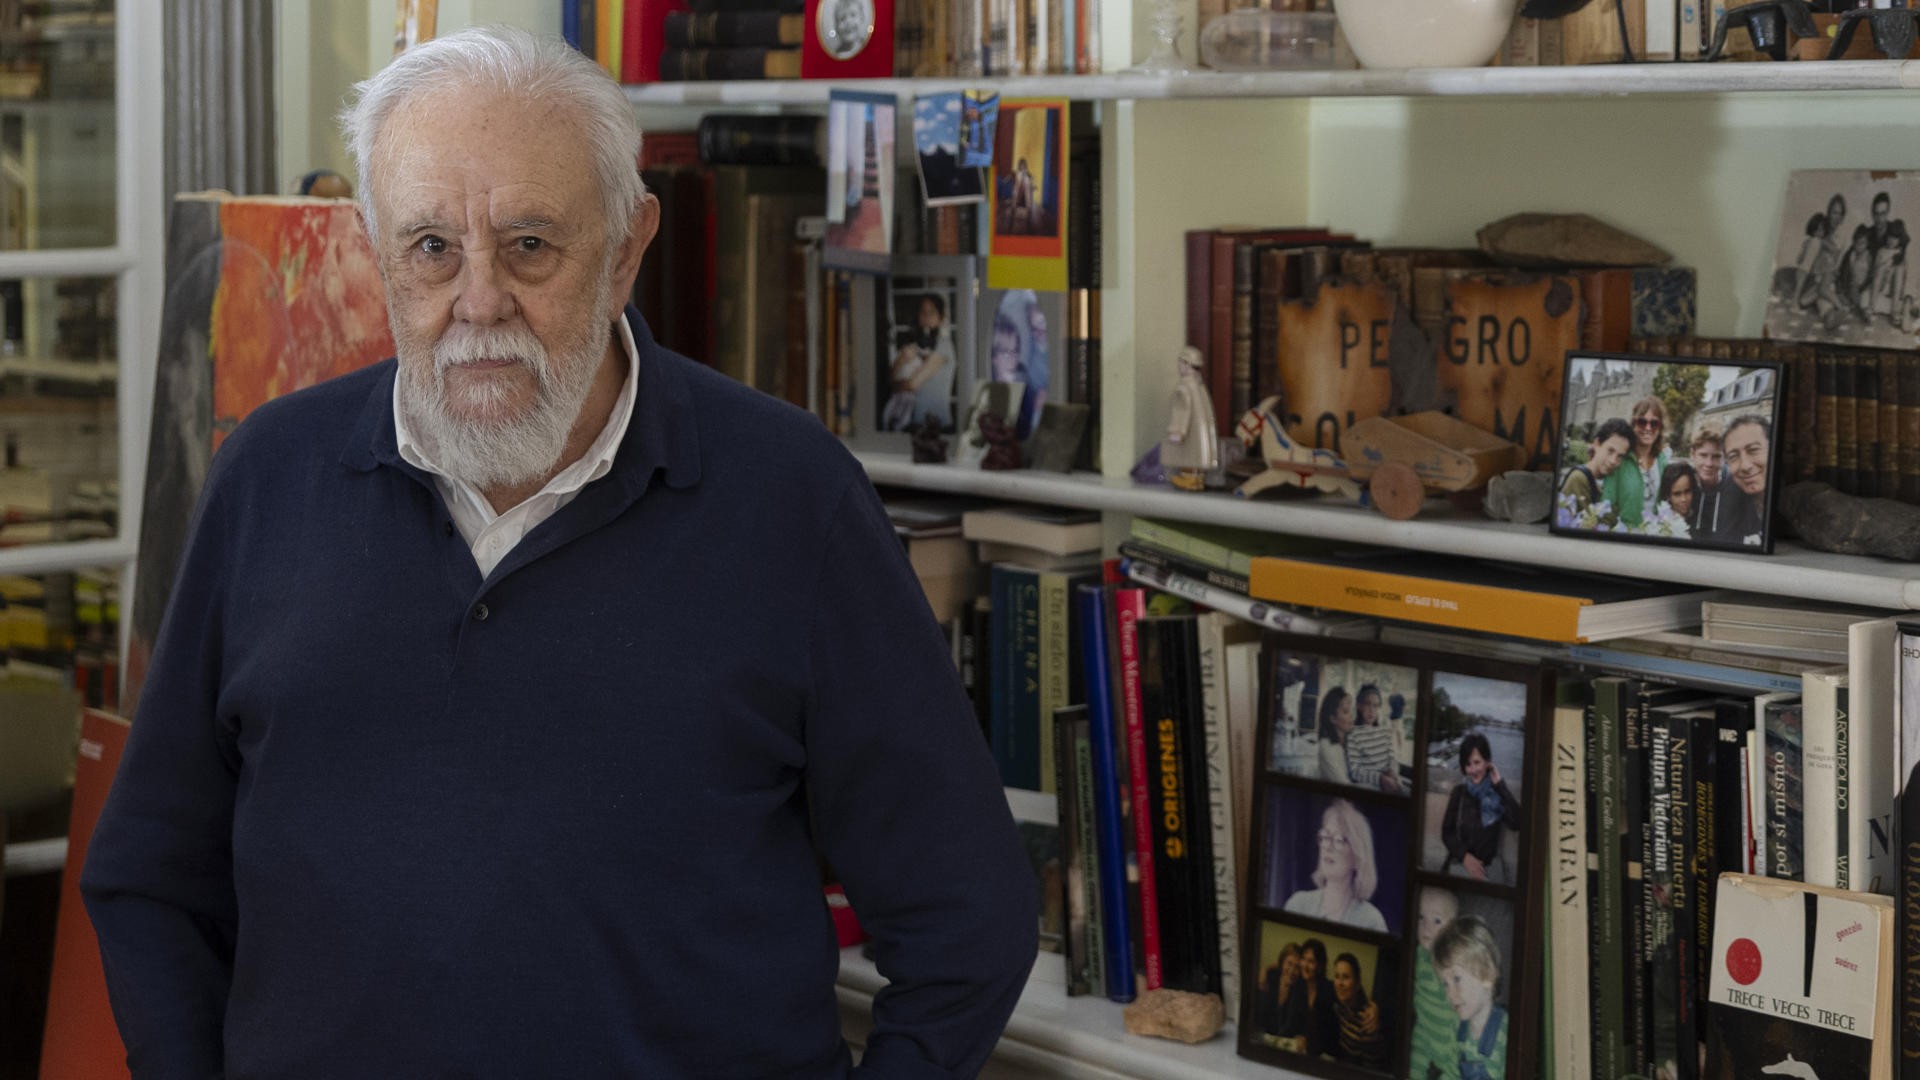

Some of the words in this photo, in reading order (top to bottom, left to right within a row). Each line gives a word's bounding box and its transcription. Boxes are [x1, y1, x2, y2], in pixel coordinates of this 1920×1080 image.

[1340, 315, 1531, 368] PEGRO
[1121, 609, 1137, 657] Obras
[1125, 660, 1139, 726] Maestras
[1625, 708, 1638, 749] Rafael
[1653, 727, 1669, 788] Pintura
[1837, 709, 1847, 809] ARCIMBOLDO
[1159, 719, 1180, 831] ORIGENES
[1670, 737, 1688, 836] Naturaleza
[1774, 751, 1787, 816] mismo
[1558, 743, 1579, 908] ZURBARAN
[1655, 794, 1671, 871] Victoriana
[1697, 781, 1707, 862] BODEGONES
[1774, 820, 1787, 839] sí
[1672, 843, 1686, 908] muerta
[1776, 843, 1791, 876] por
[1727, 988, 1765, 1010] TRECE
[1772, 998, 1810, 1019] VECES
[1817, 1009, 1856, 1031] TRECE
